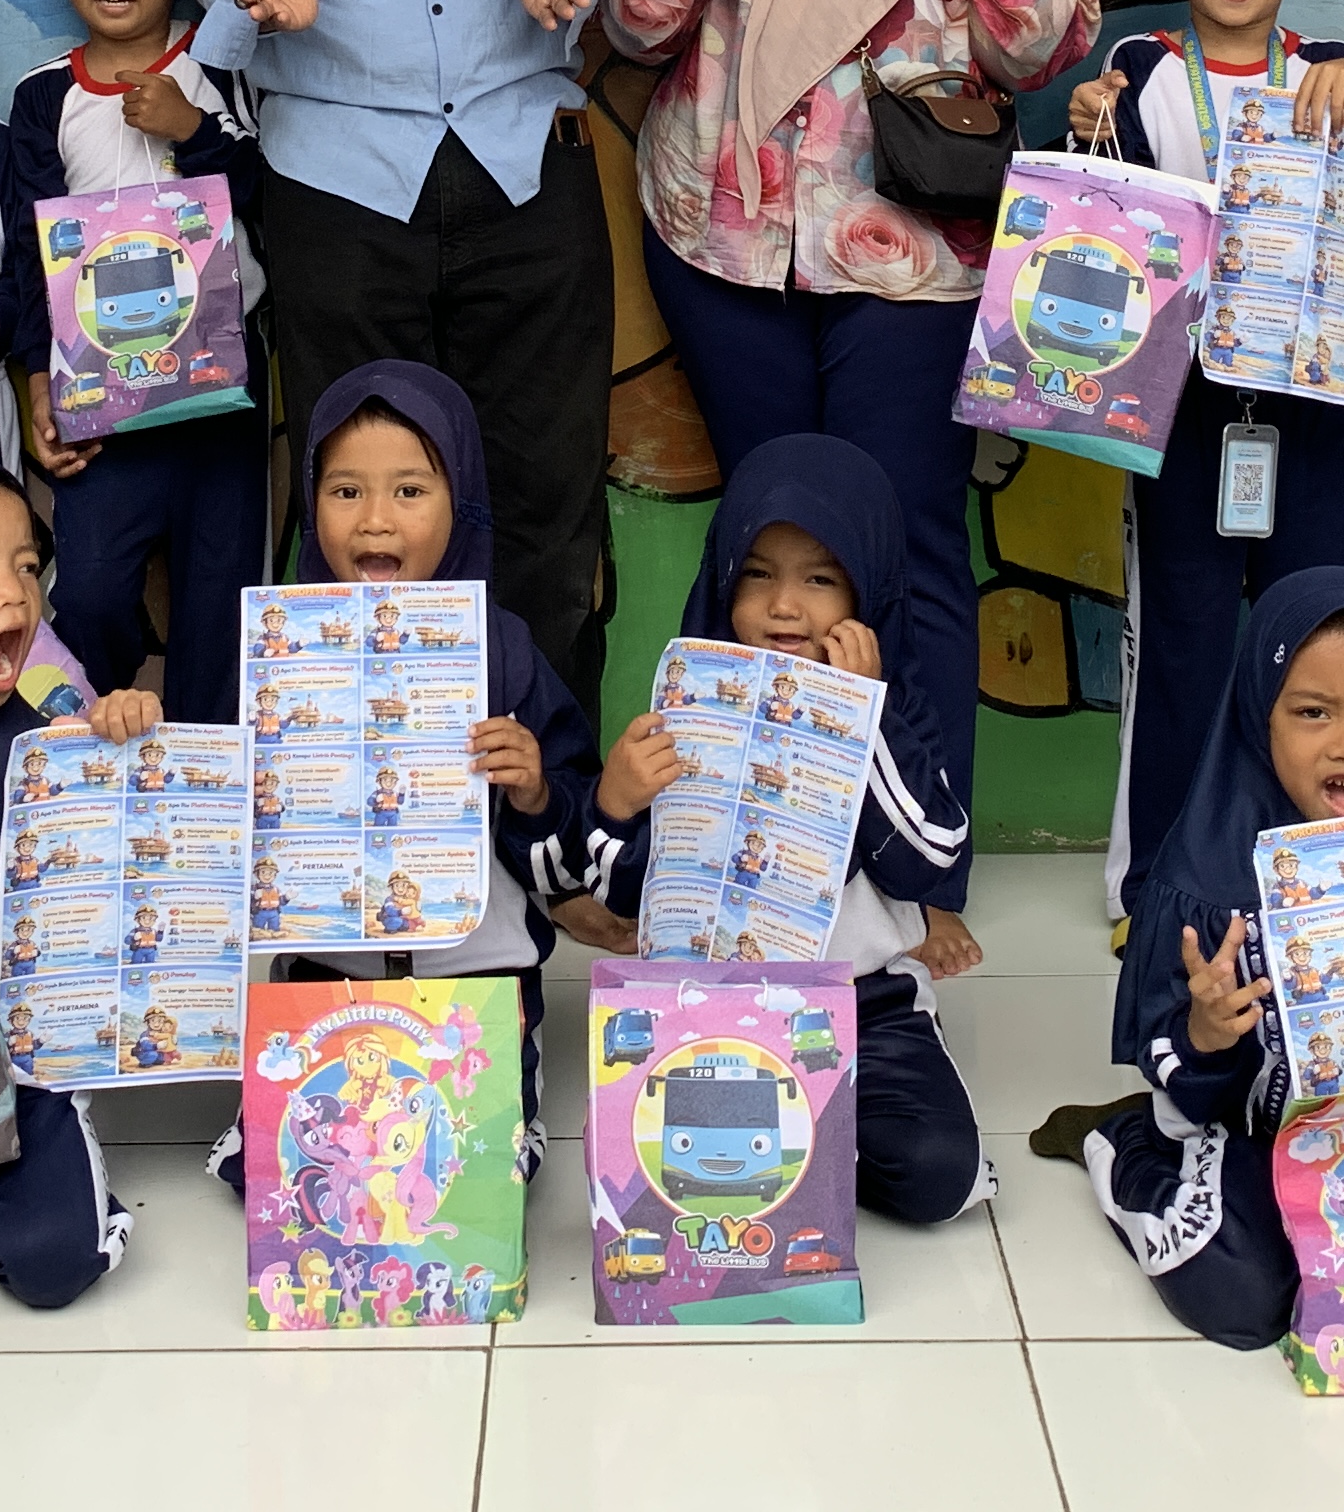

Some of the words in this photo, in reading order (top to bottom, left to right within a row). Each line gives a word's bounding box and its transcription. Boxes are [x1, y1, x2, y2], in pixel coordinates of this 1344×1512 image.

[110, 254, 127, 262] 120
[1067, 253, 1084, 262] 120
[109, 350, 179, 379] TAYO
[1028, 361, 1102, 405] TAYO
[1291, 824, 1334, 840] PROFESI
[57, 1003, 100, 1012] PERTAMINA
[688, 1068, 712, 1078] 120
[674, 1215, 774, 1255] TAYO
[701, 1256, 718, 1266] The
[719, 1256, 747, 1266] Little
[747, 1256, 768, 1267] Bus
